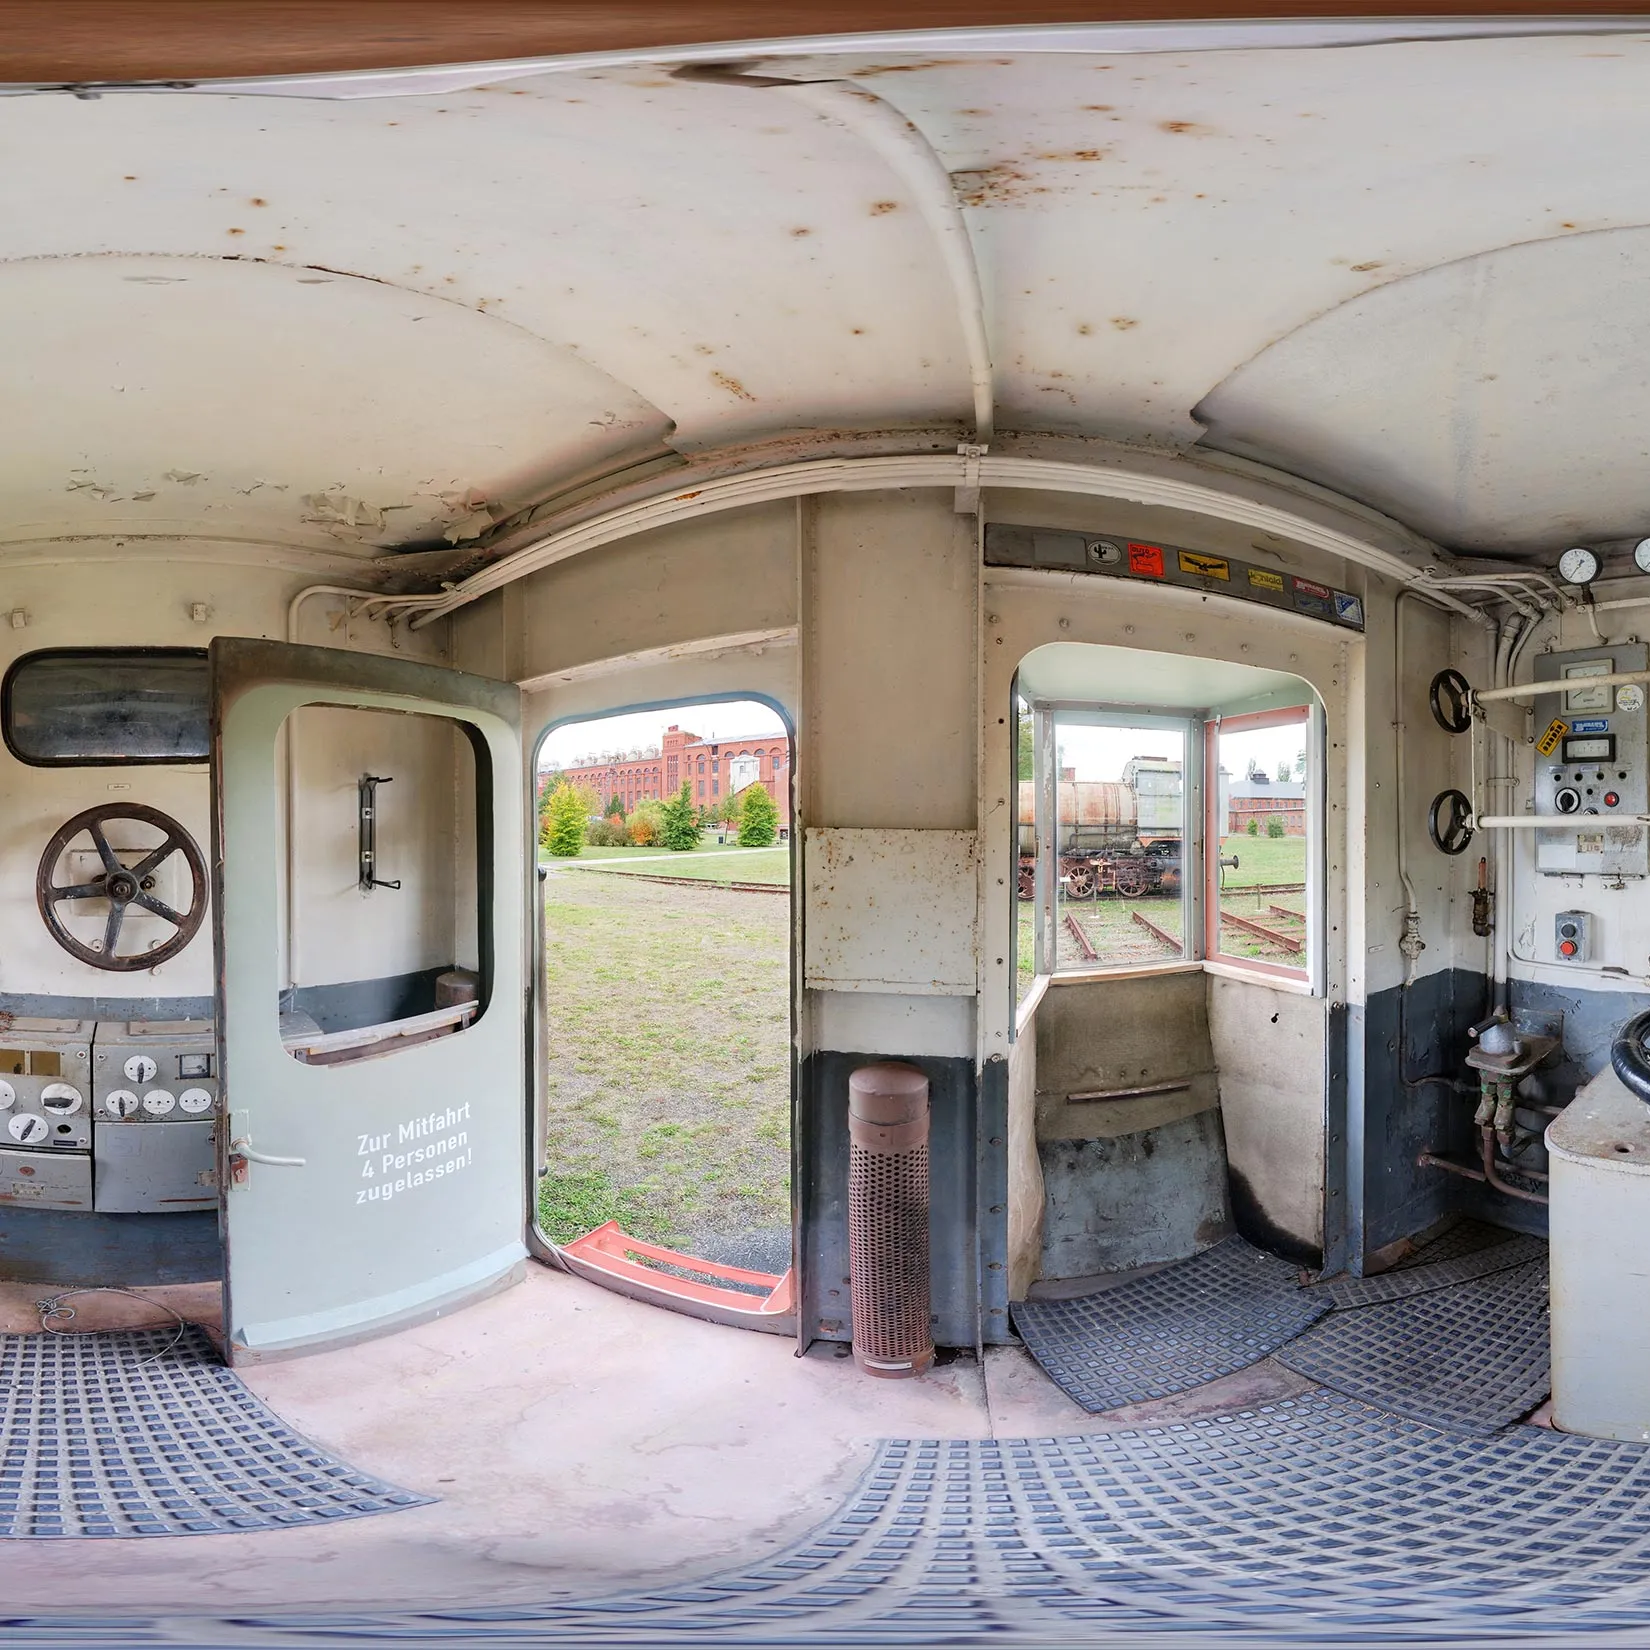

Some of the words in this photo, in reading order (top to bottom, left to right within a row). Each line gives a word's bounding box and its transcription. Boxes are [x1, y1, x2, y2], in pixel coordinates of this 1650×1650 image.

[357, 1133, 391, 1155] Zur
[398, 1101, 470, 1144] Mitfahrt
[361, 1159, 375, 1178] 4
[382, 1131, 468, 1174] Personen
[356, 1147, 472, 1204] zugelassen!
